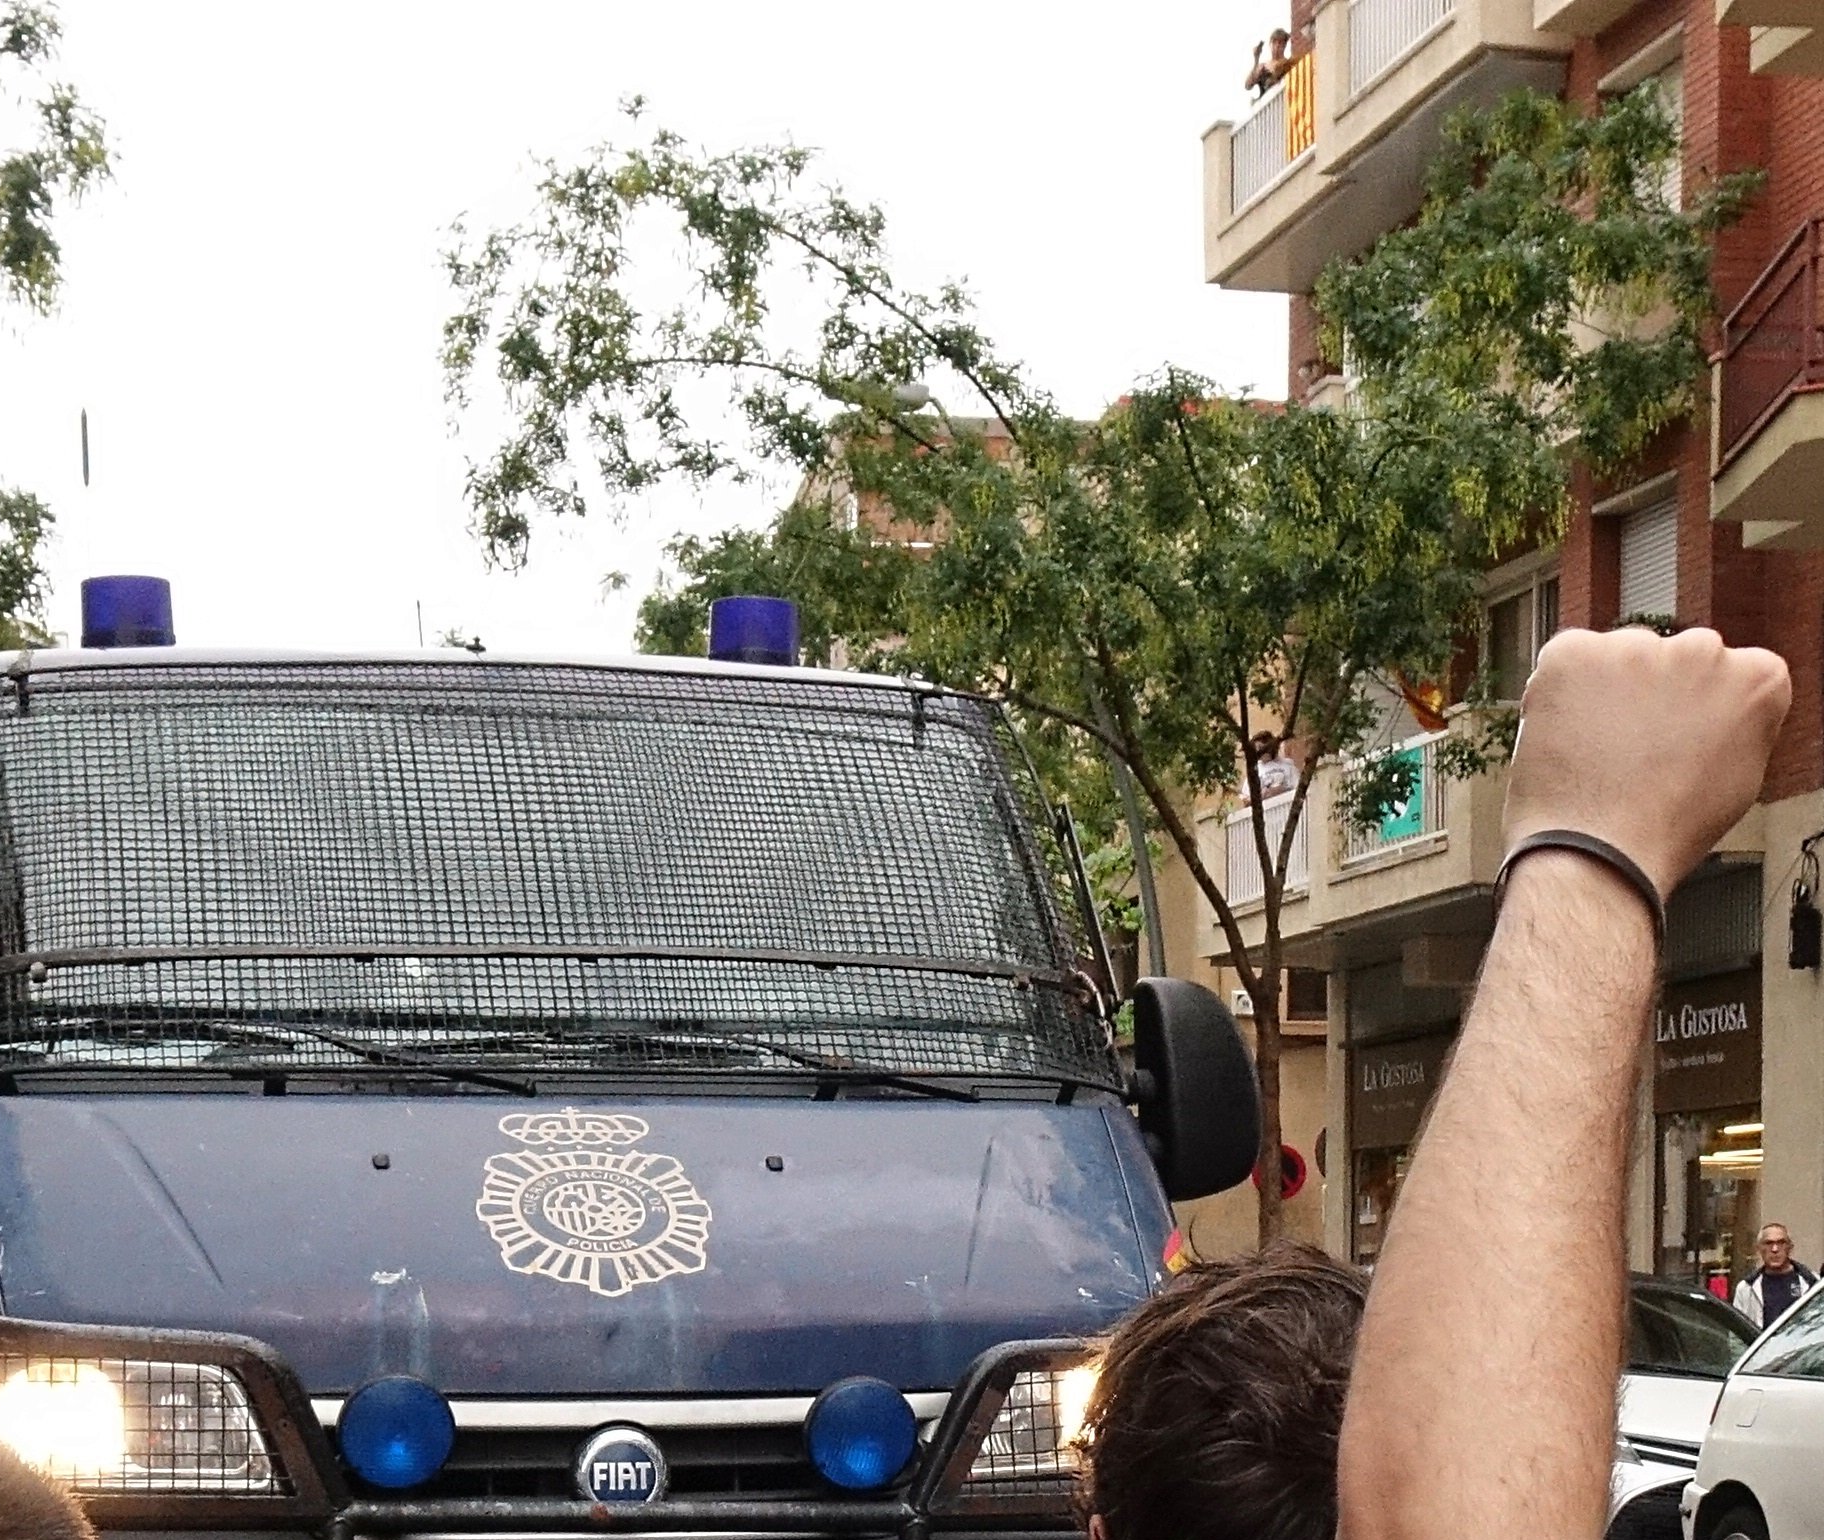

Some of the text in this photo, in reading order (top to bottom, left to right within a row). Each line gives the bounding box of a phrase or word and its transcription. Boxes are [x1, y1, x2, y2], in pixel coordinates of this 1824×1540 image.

[1656, 1002, 1749, 1043] LA GUSTOSA
[523, 1170, 667, 1215] CUERPO NACIONAL DE
[566, 1237, 639, 1252] POLICIA
[593, 1461, 652, 1491] FIAT
